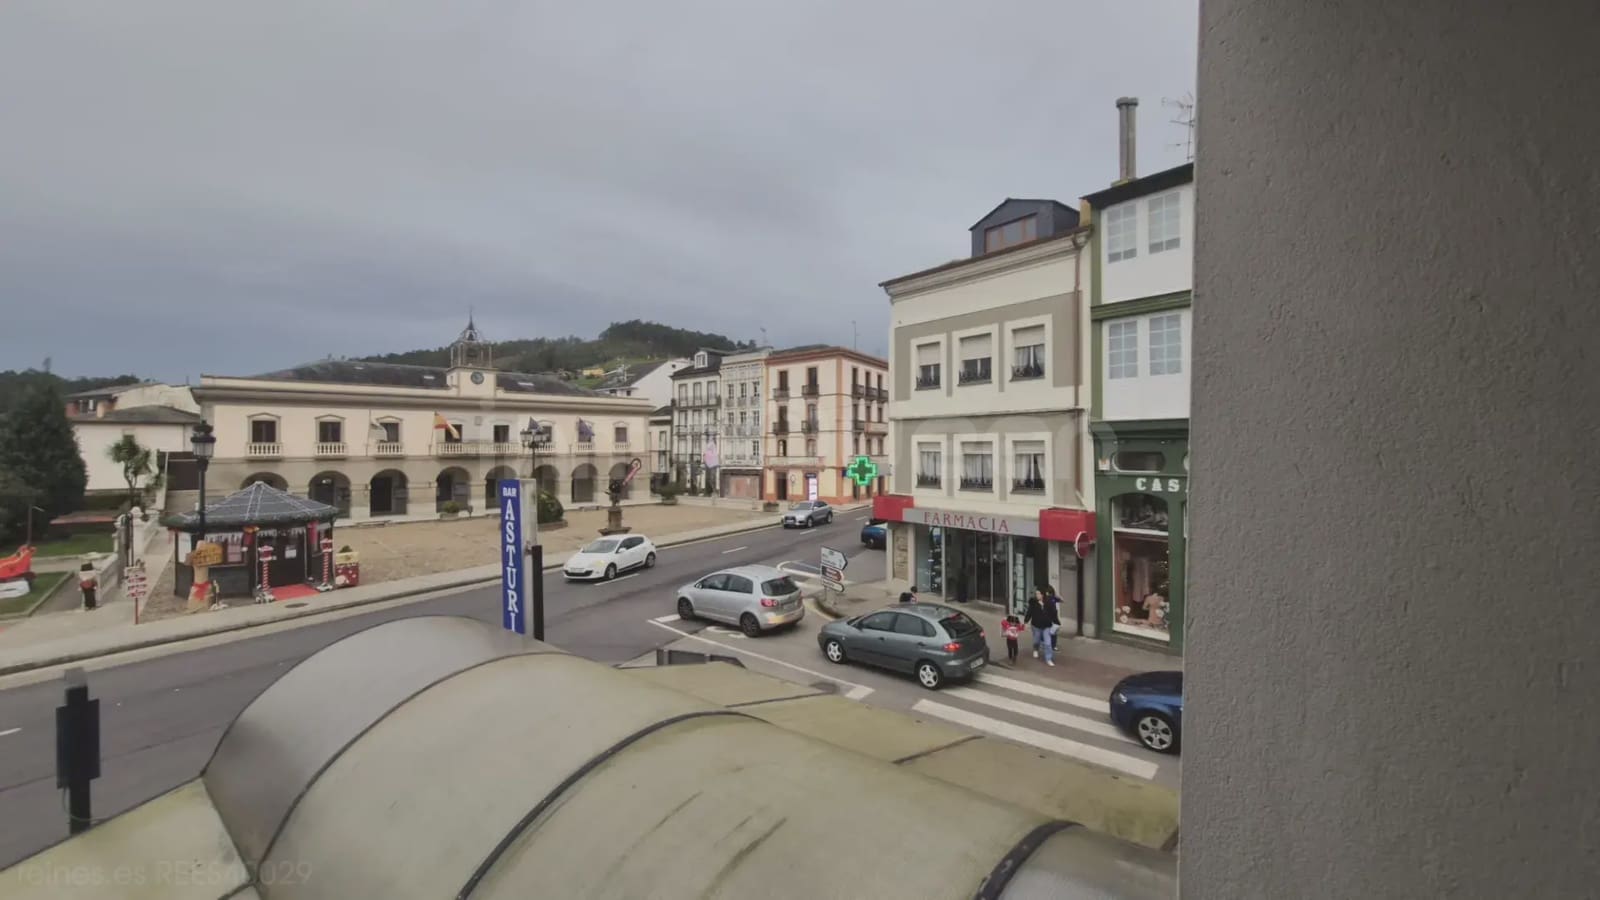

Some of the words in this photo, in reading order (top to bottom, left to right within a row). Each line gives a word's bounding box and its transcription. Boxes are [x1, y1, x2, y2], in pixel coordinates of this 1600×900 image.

[502, 486, 518, 497] BAR
[1136, 477, 1188, 493] CAS
[923, 511, 1009, 533] FARMACIA
[504, 499, 519, 632] ASTURI
